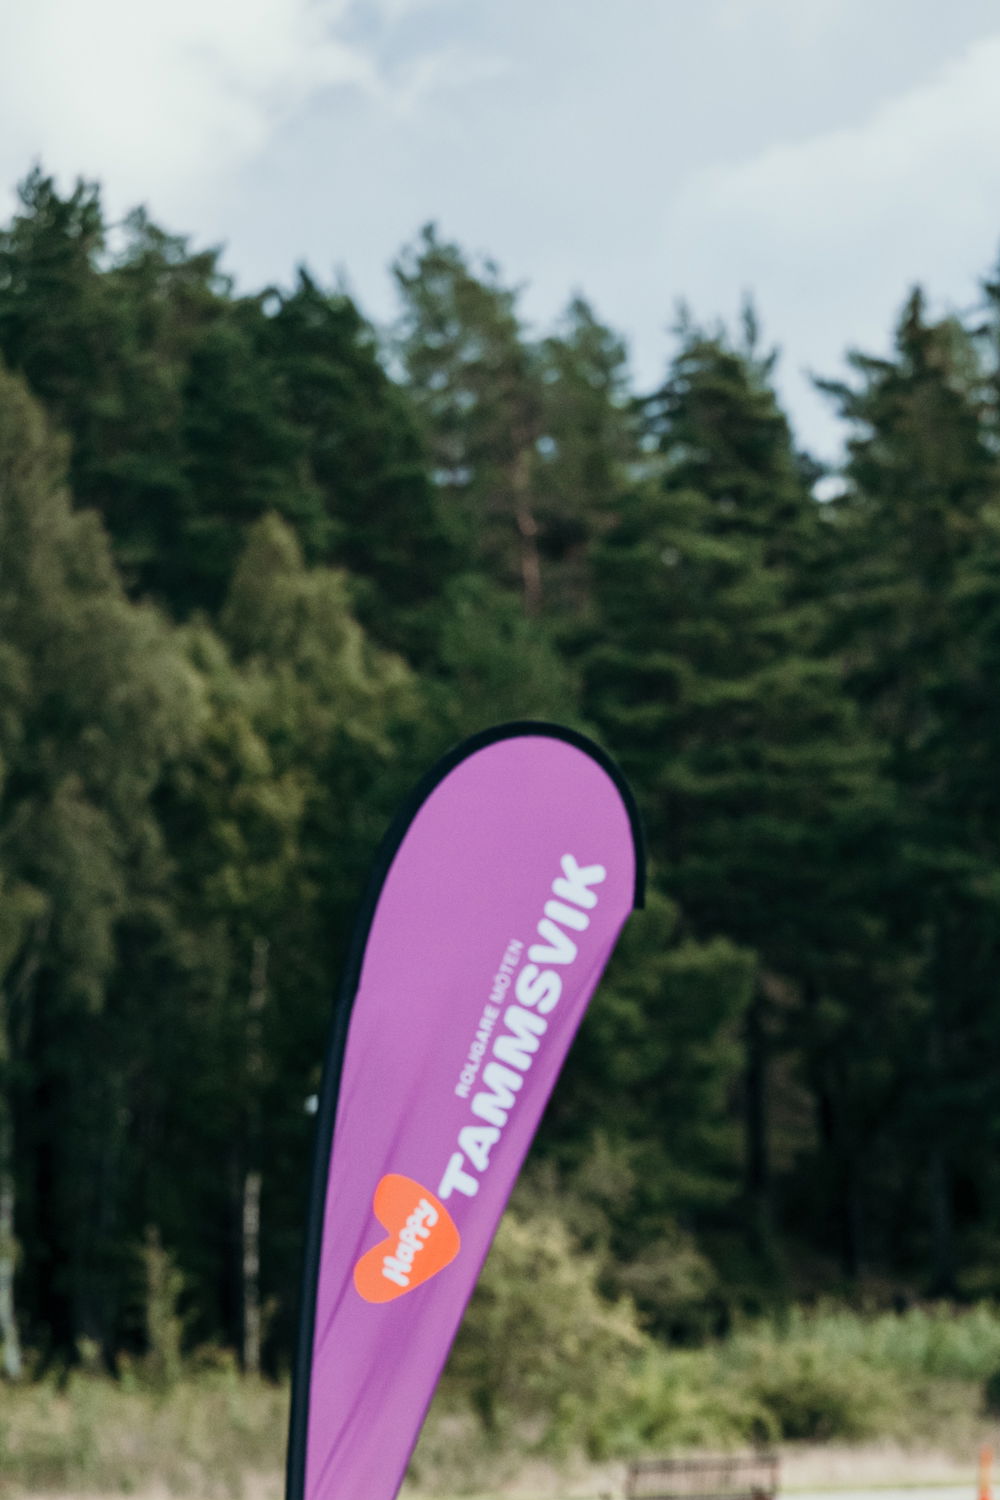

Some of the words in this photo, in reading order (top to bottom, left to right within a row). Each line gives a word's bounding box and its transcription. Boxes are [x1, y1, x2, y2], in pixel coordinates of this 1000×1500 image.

[437, 853, 607, 1200] TAMMSVIK
[454, 1004, 500, 1099] ROLIGARE
[382, 1198, 440, 1288] Happy
